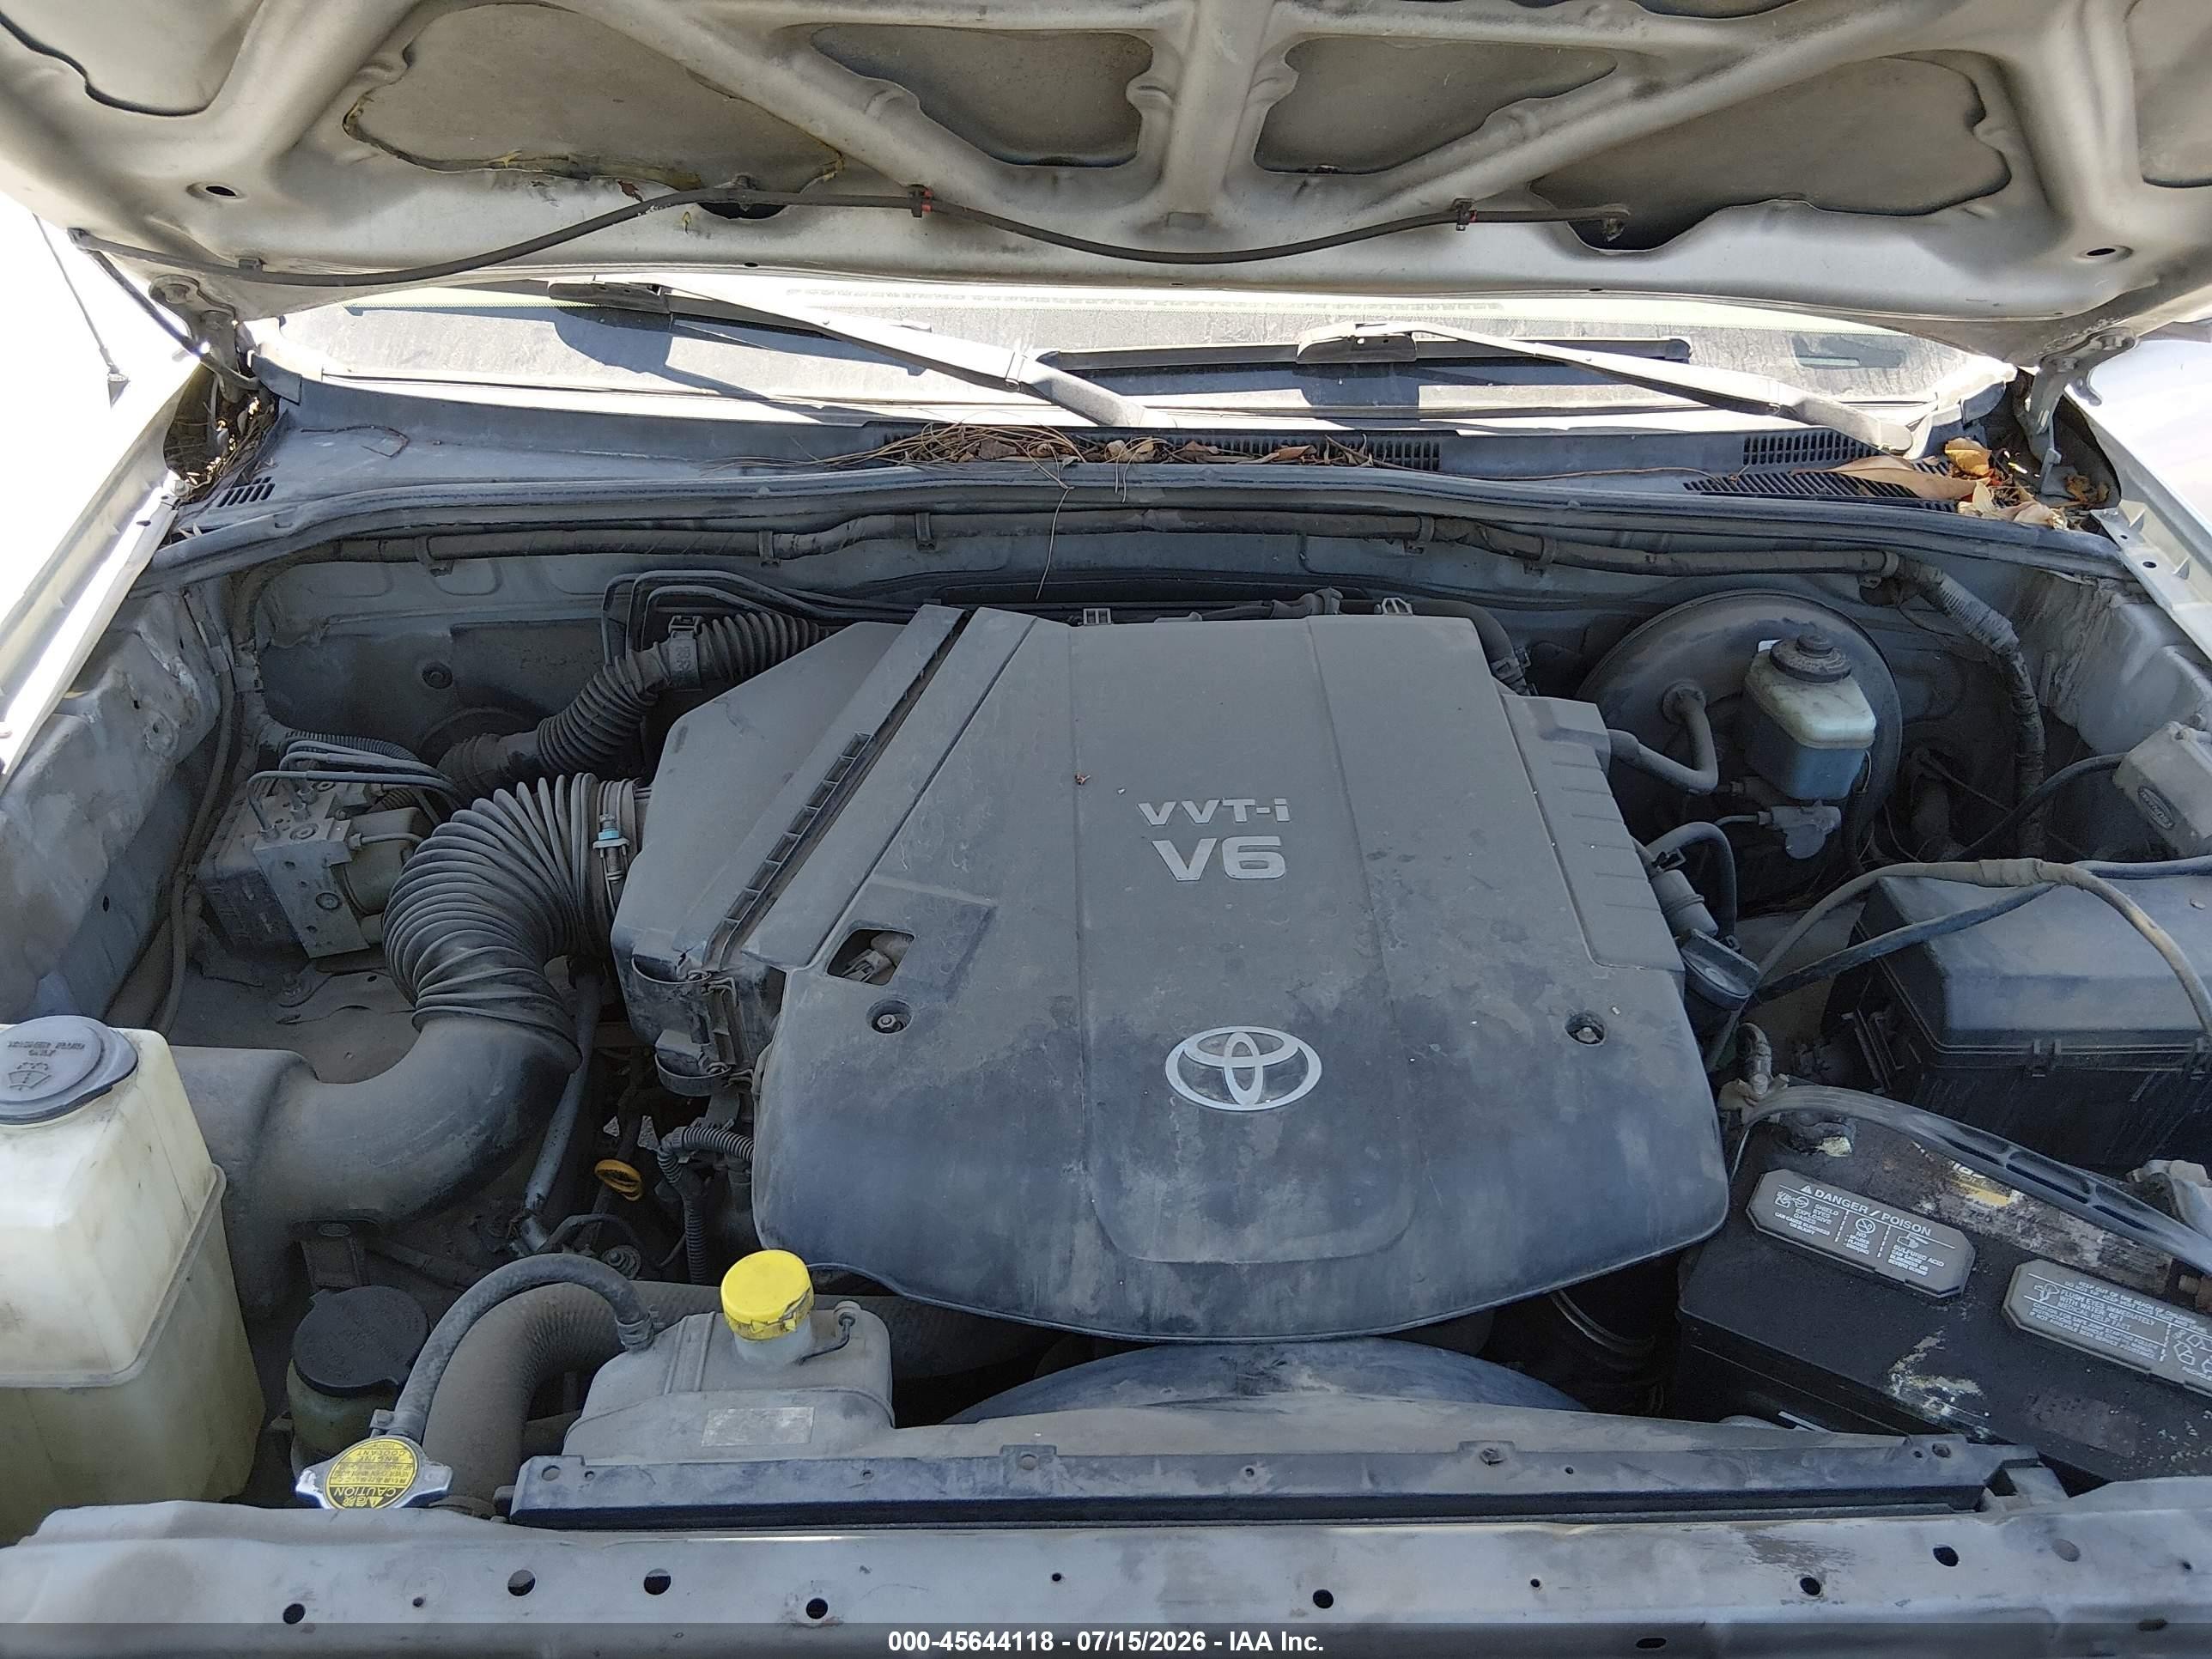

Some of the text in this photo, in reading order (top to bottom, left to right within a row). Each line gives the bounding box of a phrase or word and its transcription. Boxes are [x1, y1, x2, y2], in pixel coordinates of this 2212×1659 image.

[1138, 799, 1291, 825] VVT-i
[1152, 836, 1285, 881] V6
[1814, 1188, 1869, 1213] DANGER
[1881, 1212, 1931, 1236] POISON
[1928, 1258, 1944, 1267] ACID
[2057, 1302, 2089, 1316] MEDICAL
[2091, 1313, 2110, 1322] HELP
[2060, 1297, 2078, 1306] WITH
[2061, 1290, 2155, 1325] FLUSH EYES IMMEDIATELY
[333, 1486, 396, 1496] CAUTION
